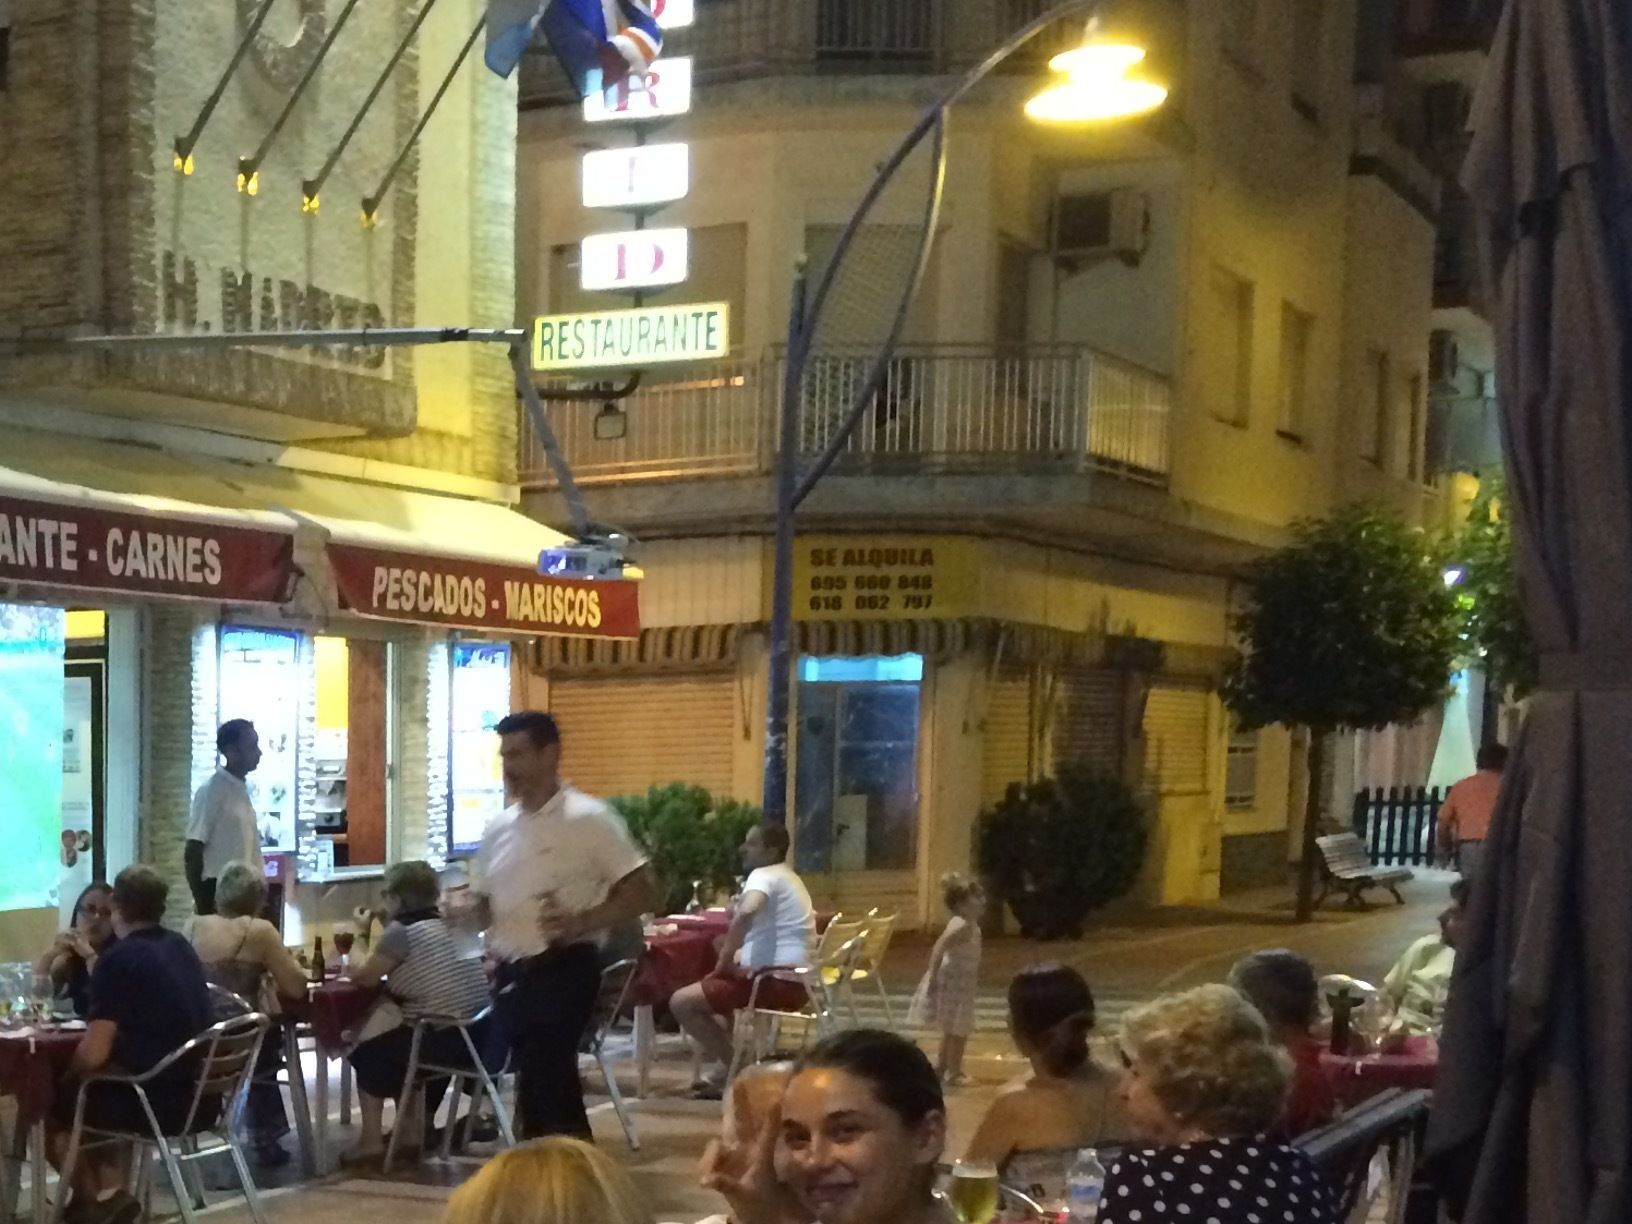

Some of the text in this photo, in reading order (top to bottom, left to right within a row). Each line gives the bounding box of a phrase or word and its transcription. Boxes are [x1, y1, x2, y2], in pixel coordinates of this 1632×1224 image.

[540, 310, 719, 362] RESTAURANTE
[105, 527, 221, 585] CARNES
[810, 548, 934, 568] SE ALQUILA
[372, 566, 486, 619] PESCADOS
[504, 580, 602, 629] MARISCOS
